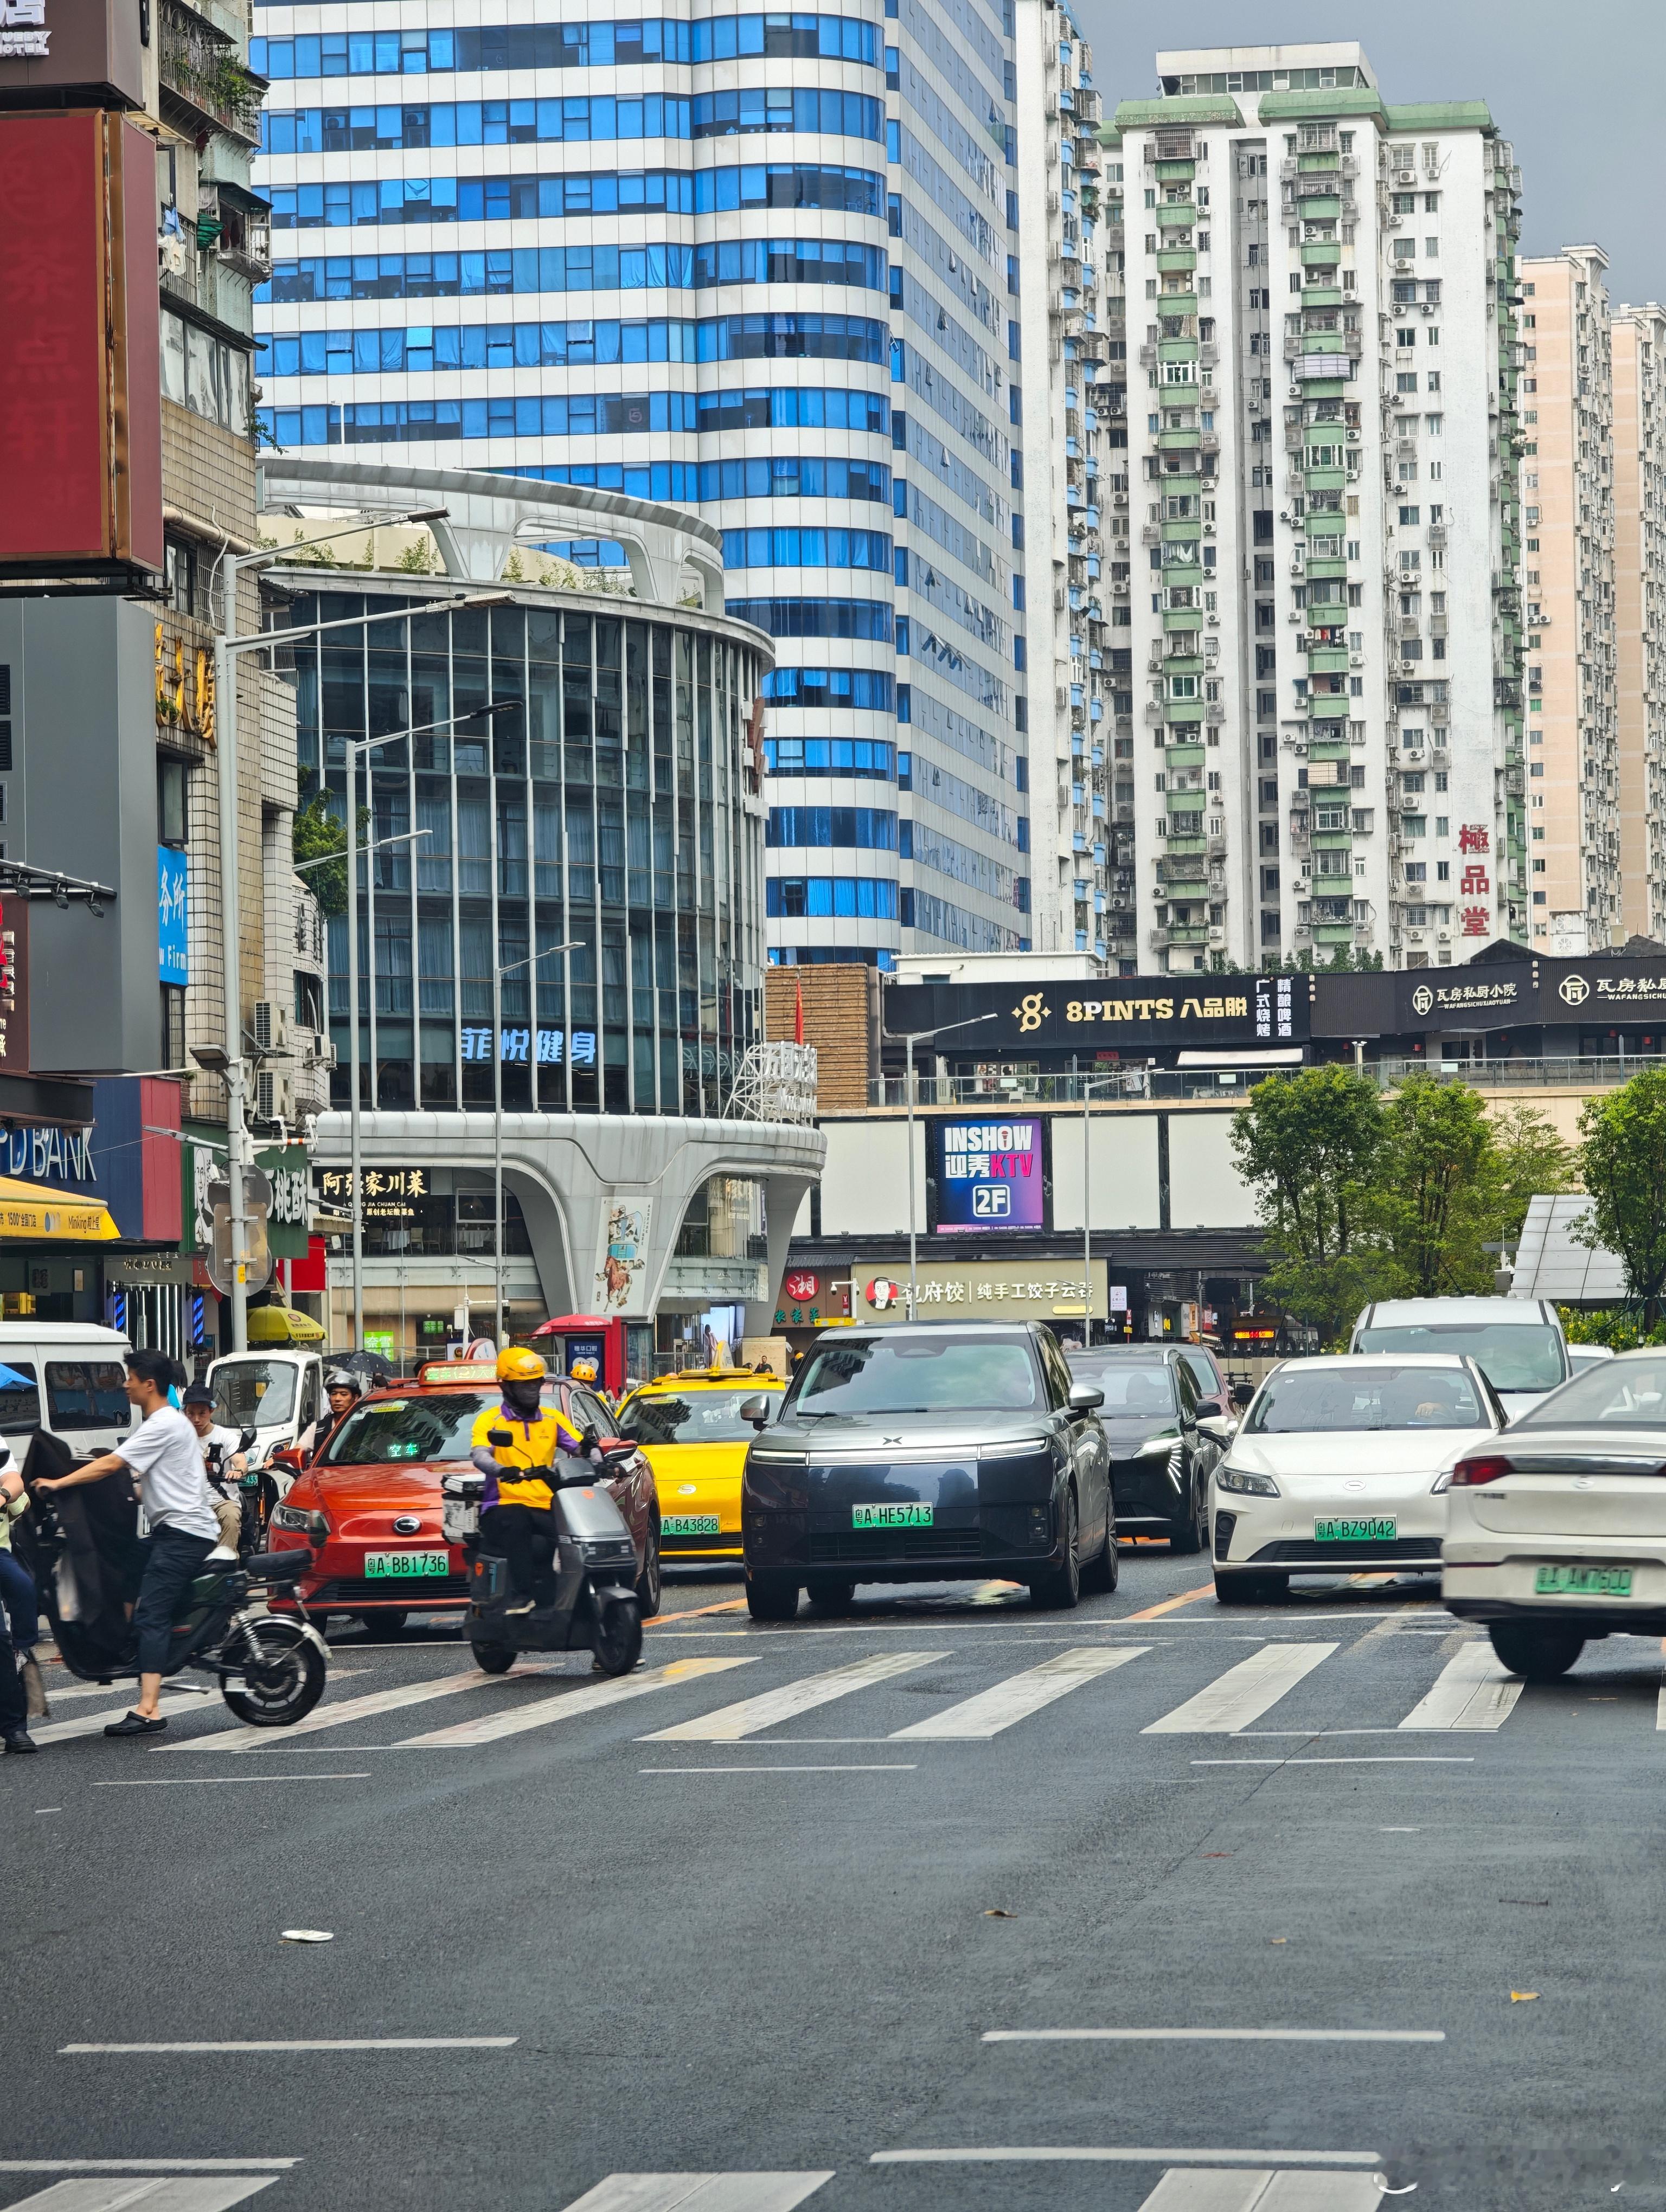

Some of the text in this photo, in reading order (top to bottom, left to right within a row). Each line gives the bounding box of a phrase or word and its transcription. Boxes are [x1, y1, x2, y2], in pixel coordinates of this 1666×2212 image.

[168, 944, 186, 970] Firm
[1437, 982, 1518, 1002] 瓦房私厨小院
[1066, 997, 1247, 1022] 8PINTS 八品脱
[1256, 979, 1271, 1037] 广式烧烤
[1277, 978, 1293, 1037] 精酿啤酒
[460, 1027, 595, 1064] 菲悦健身
[945, 1126, 1033, 1152] INSHOW
[977, 1189, 1007, 1213] 2F
[389, 1443, 418, 1457] 空车
